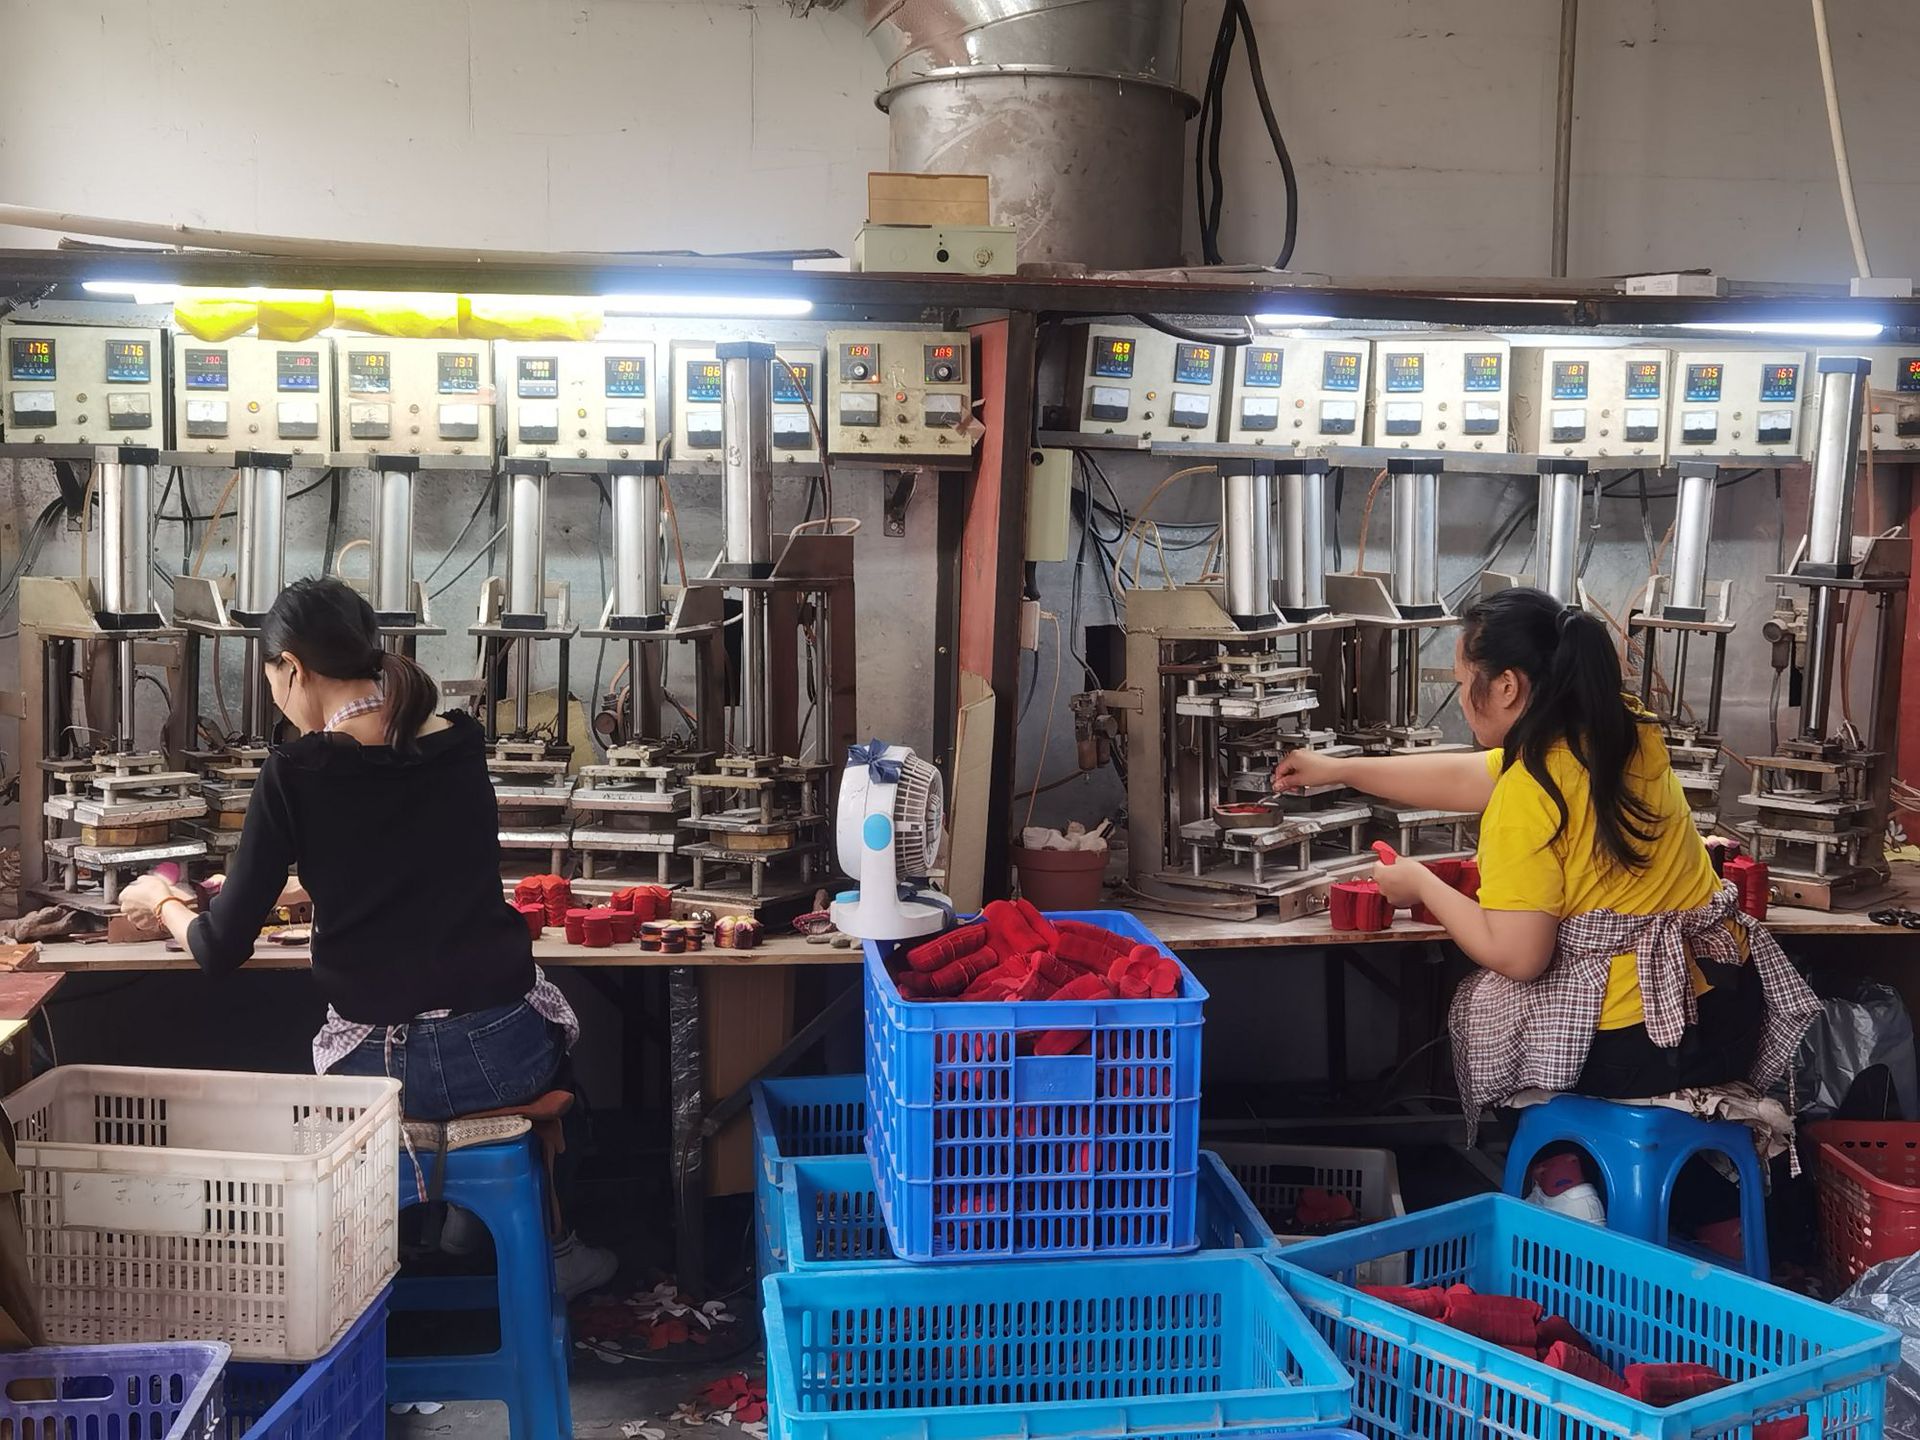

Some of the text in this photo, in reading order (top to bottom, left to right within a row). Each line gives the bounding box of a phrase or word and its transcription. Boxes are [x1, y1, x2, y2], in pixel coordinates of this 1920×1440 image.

[29, 342, 49, 354] 176
[124, 344, 144, 356] 176
[851, 347, 869, 357] 190
[1112, 342, 1130, 353] 169
[1193, 349, 1210, 360] 175
[1262, 352, 1278, 362] 187
[365, 355, 384, 366] 197
[455, 357, 473, 368] 197
[1339, 356, 1356, 367] 179
[1403, 357, 1419, 368] 175
[1481, 357, 1497, 368] 174
[618, 361, 640, 372] 201
[1568, 365, 1584, 375] 187
[1641, 365, 1657, 375] 182
[789, 367, 807, 378] 97
[1702, 368, 1718, 378] 175
[1778, 368, 1793, 378] 167
